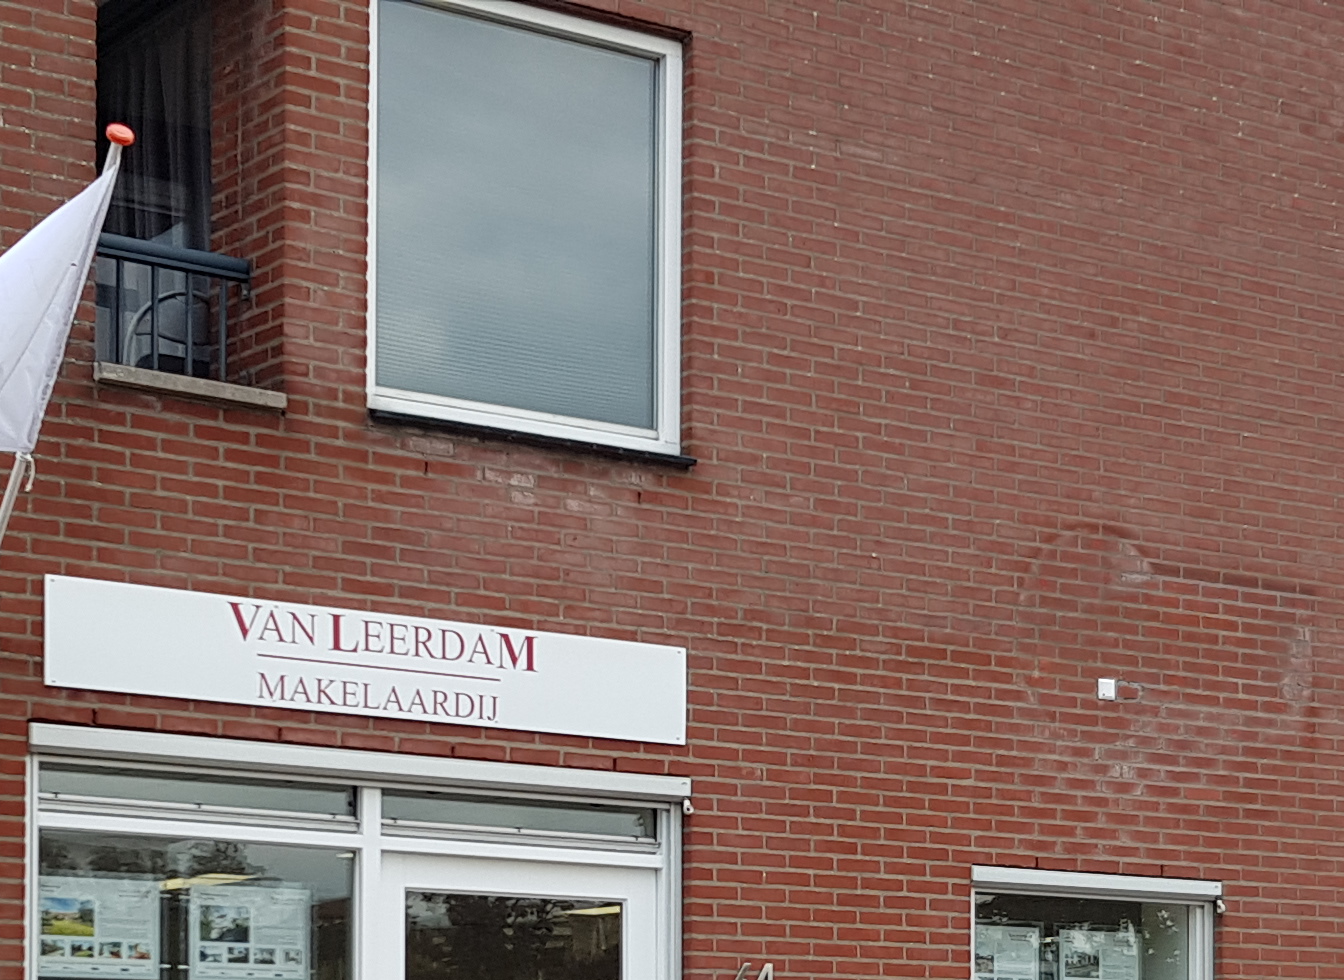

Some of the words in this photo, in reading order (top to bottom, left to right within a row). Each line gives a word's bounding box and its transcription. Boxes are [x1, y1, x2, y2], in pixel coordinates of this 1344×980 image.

[228, 601, 318, 646] VAN
[328, 612, 539, 673] LEERDAM
[257, 671, 499, 723] MAKELAARDIJ
